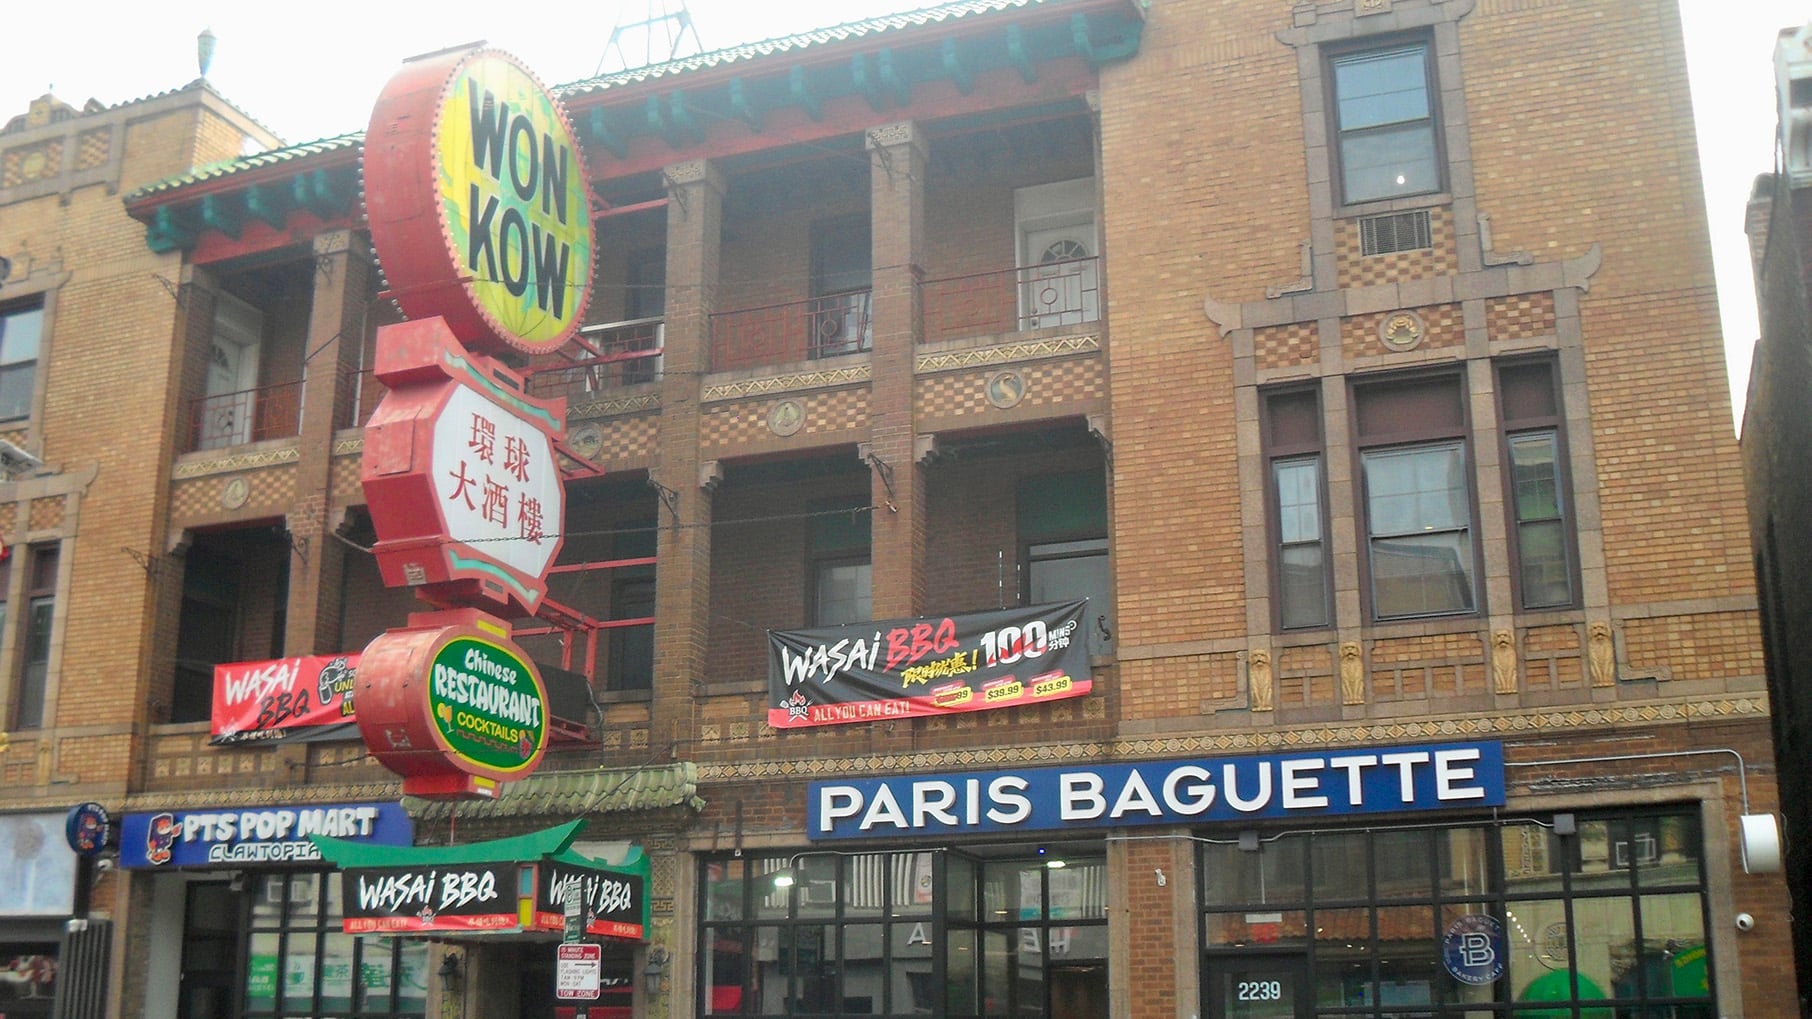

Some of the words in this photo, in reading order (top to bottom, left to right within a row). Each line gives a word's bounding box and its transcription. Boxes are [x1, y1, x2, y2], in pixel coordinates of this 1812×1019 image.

[468, 77, 567, 225] WON
[468, 183, 570, 320] KOW
[468, 412, 530, 483] 環球
[449, 460, 543, 545] 大酒樓
[882, 617, 959, 673] BBQ
[980, 620, 1049, 669] 100
[464, 648, 517, 685] Chinese
[434, 663, 541, 728] RESTAURANT
[987, 685, 1019, 700] $39.99
[1036, 680, 1068, 695] $43.99
[257, 689, 310, 728] BBQ
[456, 712, 519, 743] COCKTAILS
[789, 706, 809, 716] BBQ
[814, 707, 834, 722] ALL
[835, 705, 856, 720] YOU
[859, 703, 881, 717] CAN
[884, 701, 910, 715] EAT!
[820, 776, 1031, 832] PARIS
[1060, 748, 1486, 820] BAGUETTE
[183, 813, 237, 842] PTS
[240, 810, 296, 839] POP
[297, 807, 380, 838] MART
[439, 870, 498, 910] BBQ
[597, 879, 631, 914] BBQ
[1238, 981, 1281, 1000] 2239
